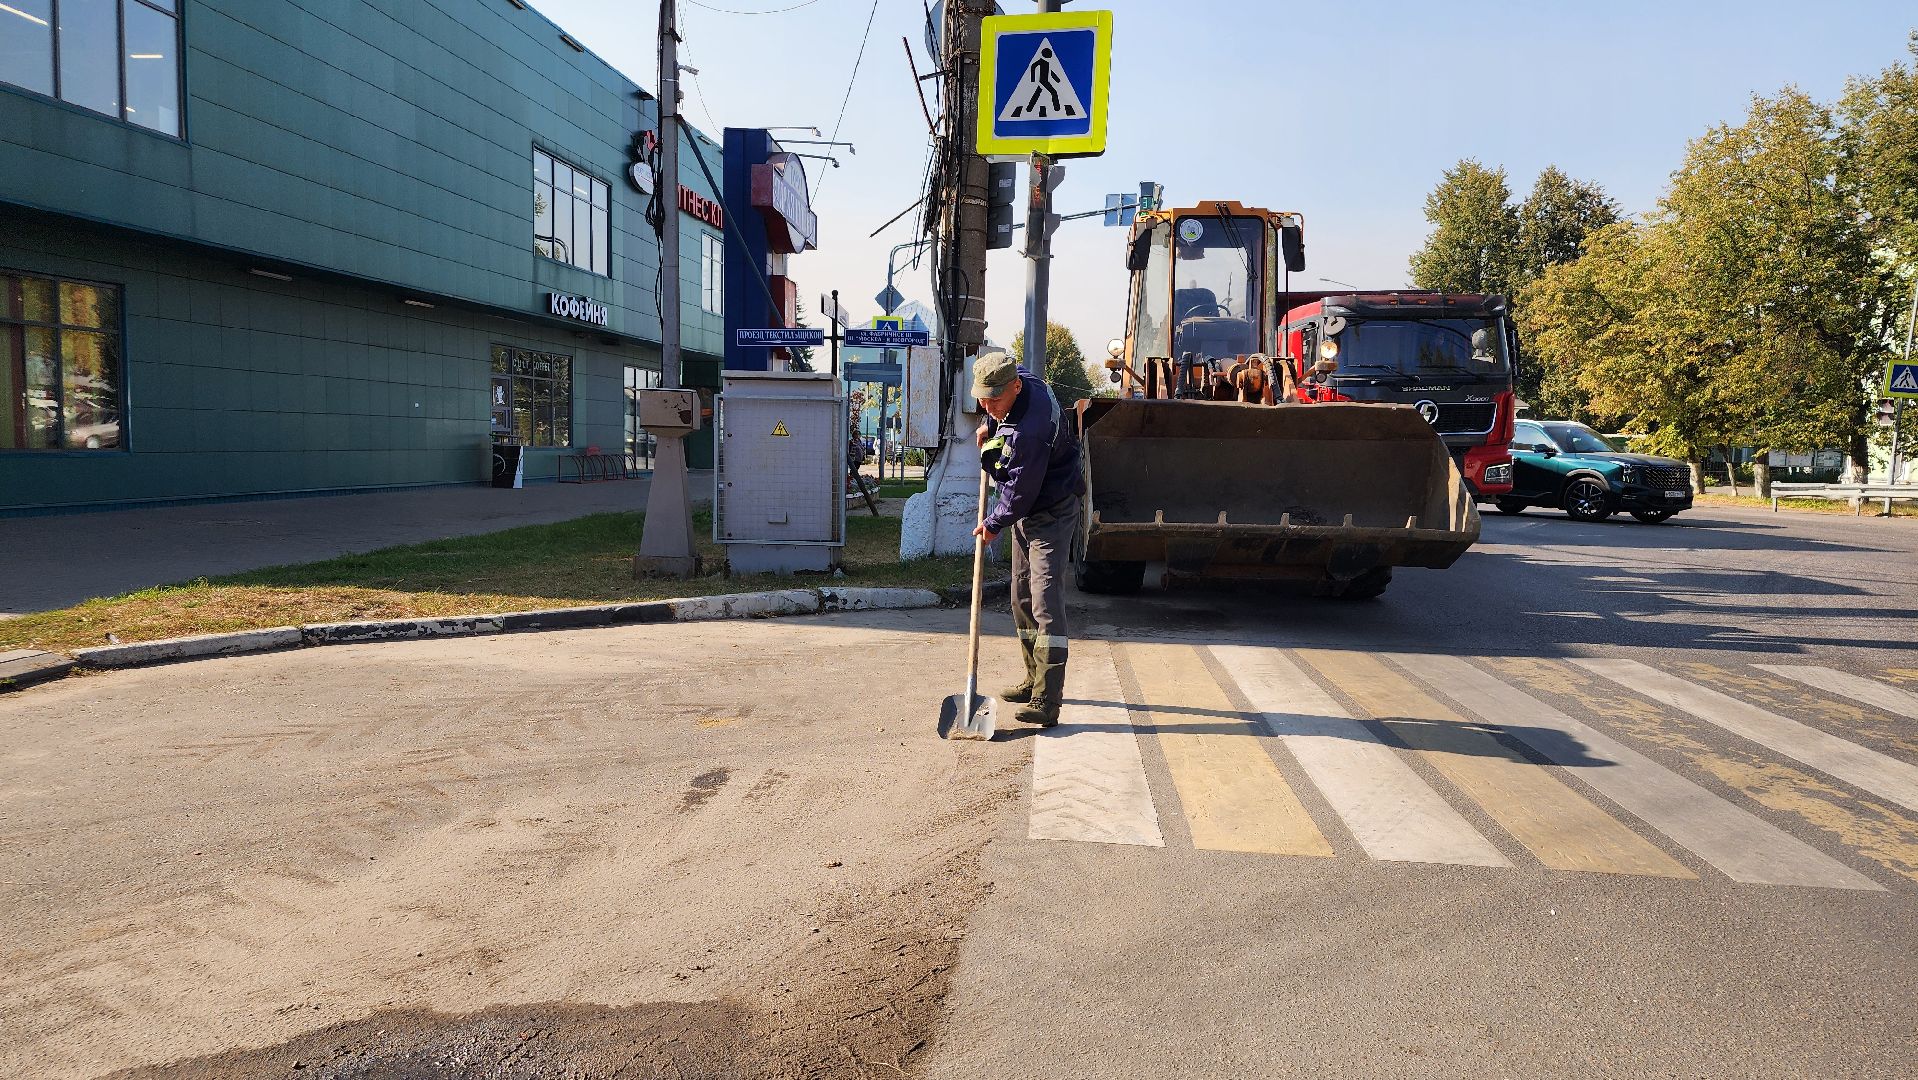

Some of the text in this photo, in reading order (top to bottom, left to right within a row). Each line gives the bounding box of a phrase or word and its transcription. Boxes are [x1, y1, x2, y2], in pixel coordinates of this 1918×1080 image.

[711, 203, 723, 229] КЛ
[551, 292, 608, 327] КОФЕЙНЯ
[739, 331, 822, 340] ПРОЕЗД ТЕКСТИЛЬЩИКОВ
